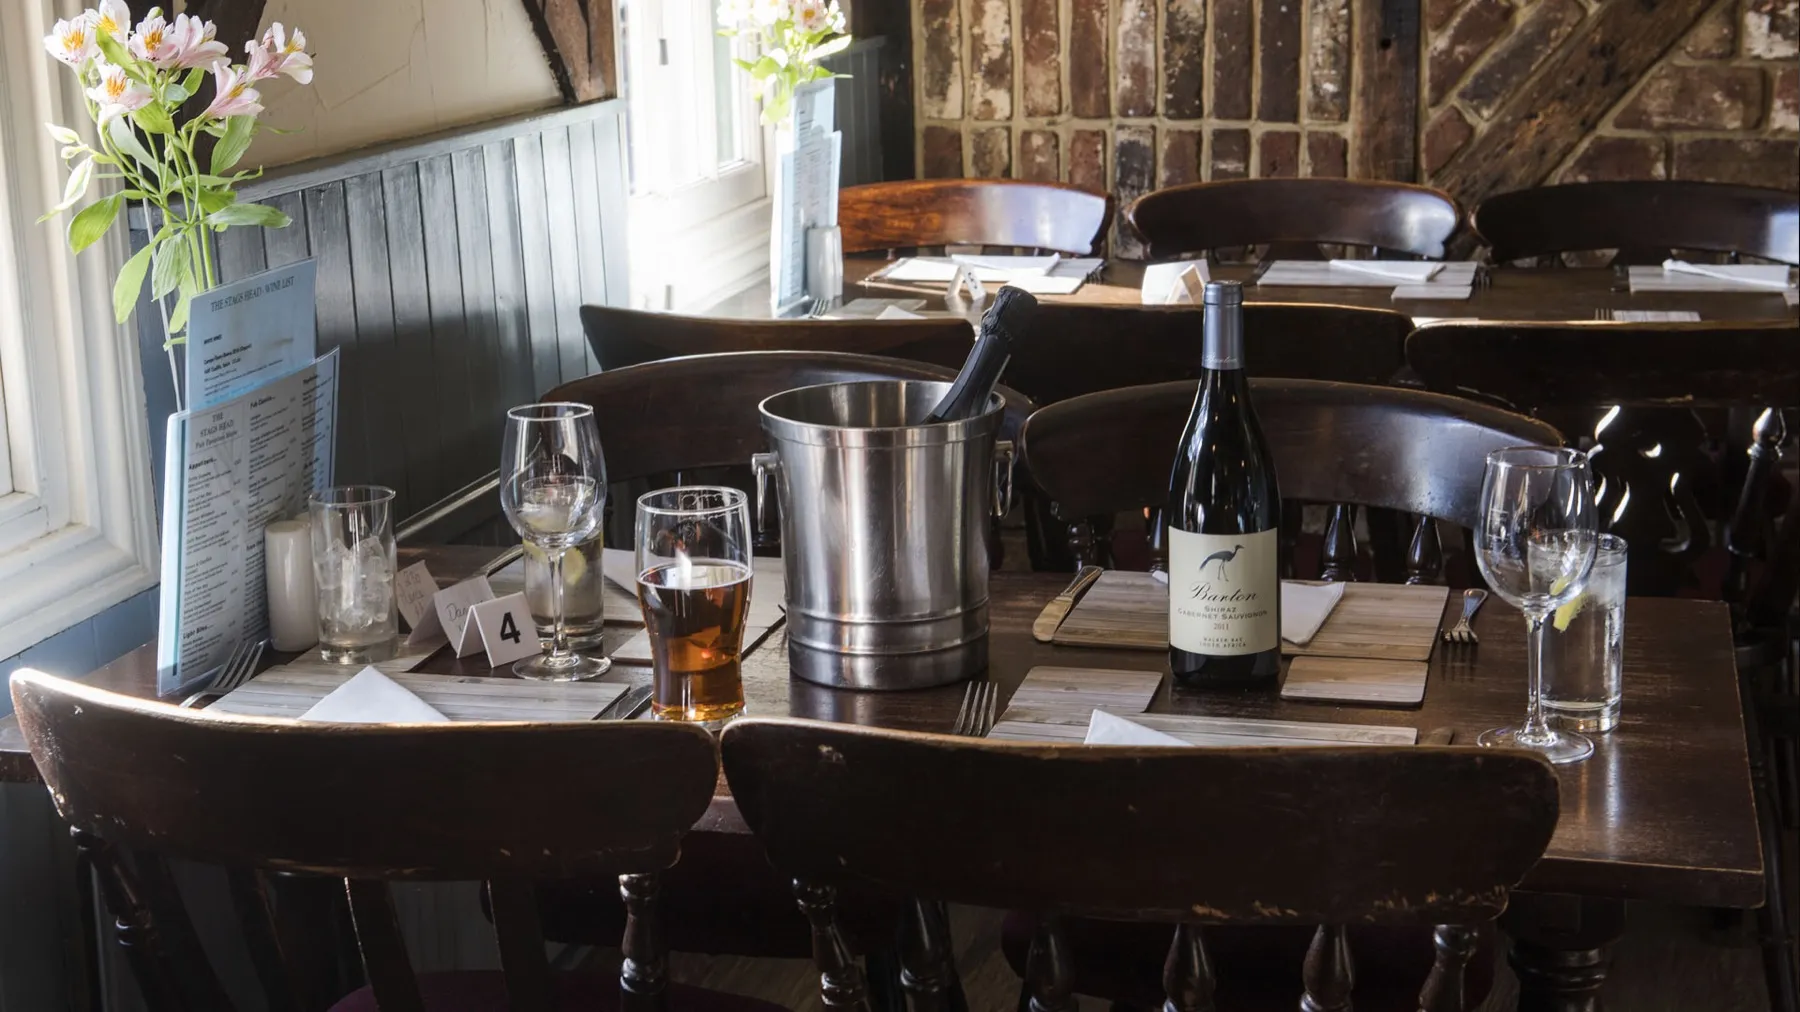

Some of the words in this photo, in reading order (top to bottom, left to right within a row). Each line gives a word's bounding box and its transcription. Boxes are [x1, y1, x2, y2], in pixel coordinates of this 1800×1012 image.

[211, 300, 223, 312] THE
[224, 292, 243, 308] STAGS
[244, 286, 262, 301] HEAD
[265, 280, 280, 293] WINE
[281, 275, 294, 288] LIST
[1190, 582, 1258, 602] Barton
[1177, 607, 1218, 620] CABERNET
[1221, 610, 1268, 620] SAUVIGNON
[500, 611, 521, 644] 4
